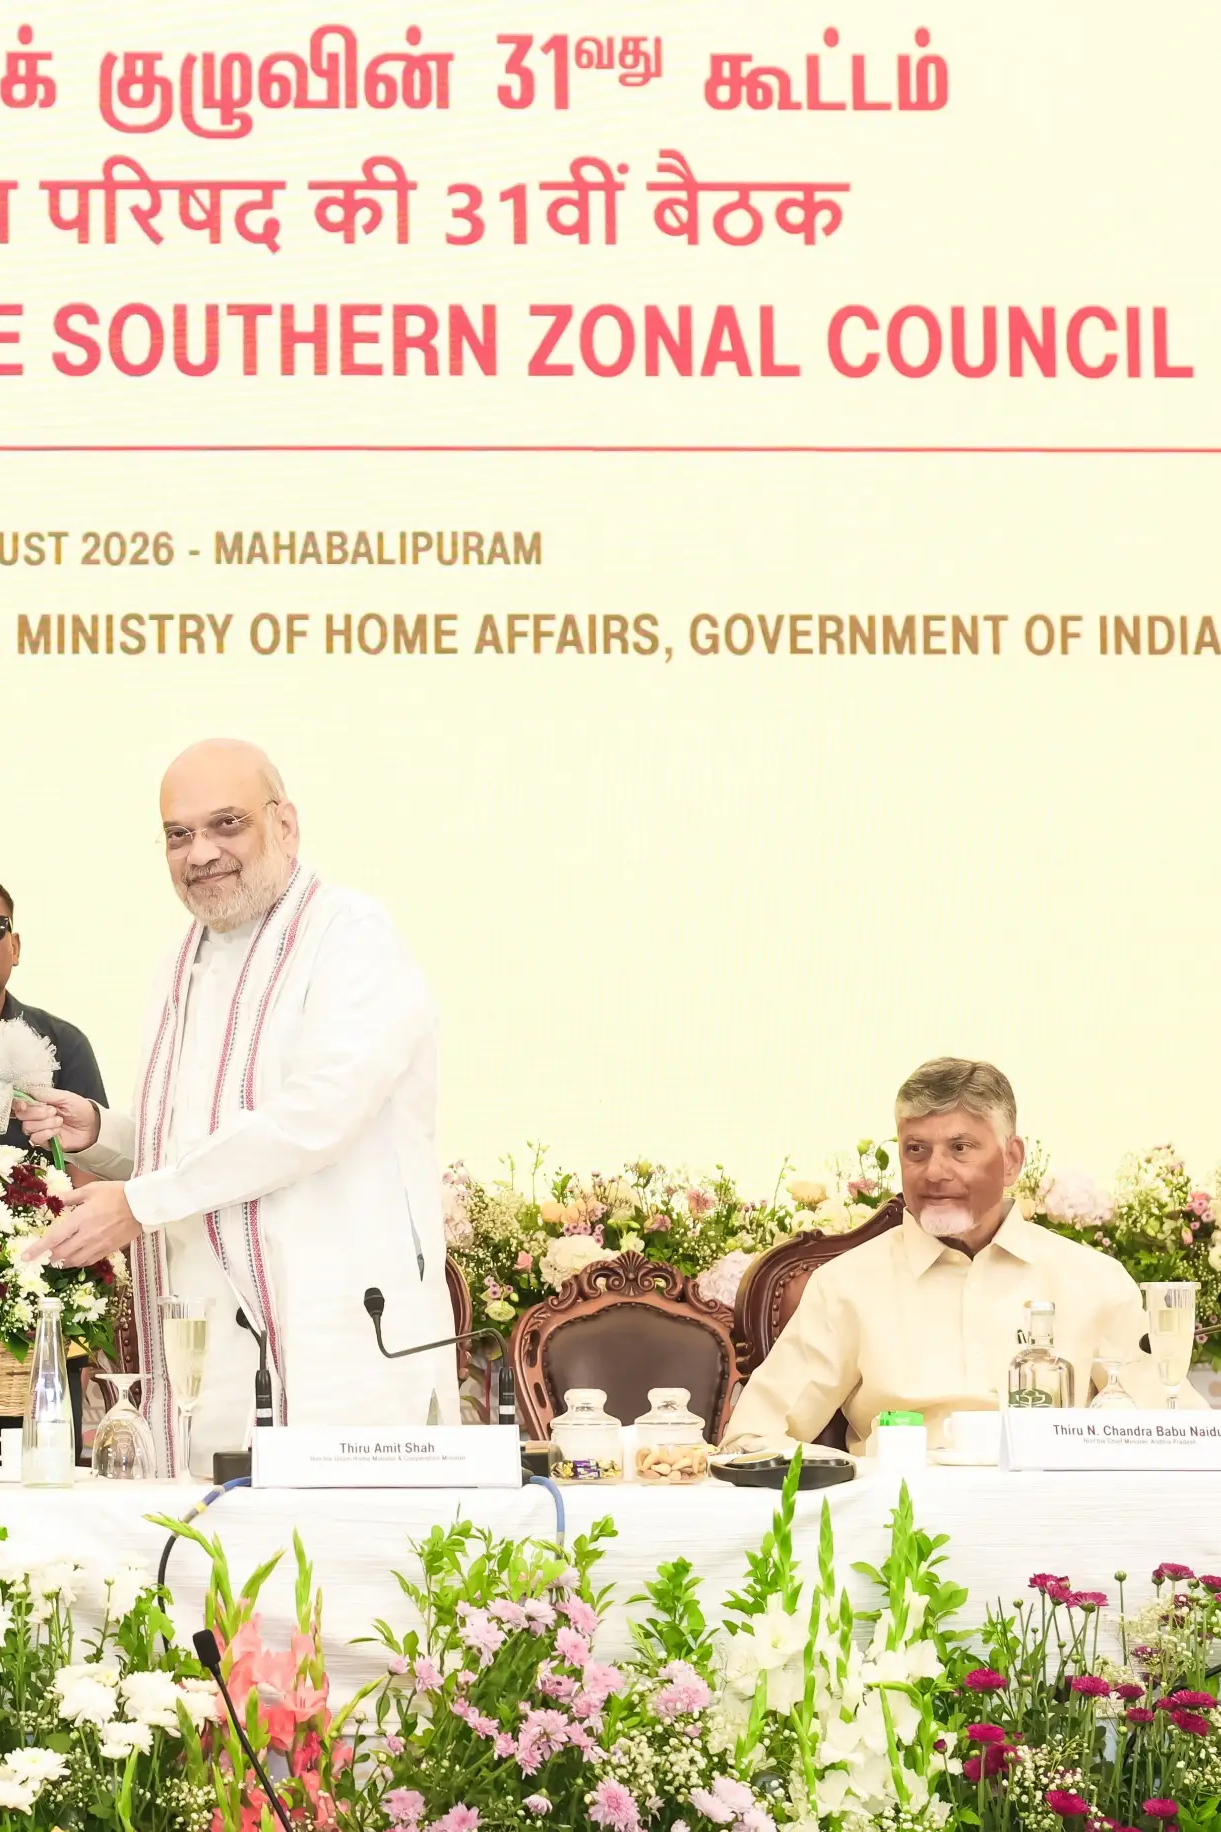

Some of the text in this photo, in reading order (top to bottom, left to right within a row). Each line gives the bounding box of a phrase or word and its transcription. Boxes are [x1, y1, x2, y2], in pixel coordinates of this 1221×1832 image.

[99, 24, 454, 139] குழுவின்
[705, 27, 948, 111] கூட்டம்
[39, 155, 286, 253] परिषद
[308, 156, 417, 244] की
[446, 156, 629, 245] 31वीं
[646, 149, 850, 246] बैठक
[52, 303, 497, 377] SOUTHERN
[528, 304, 800, 377] ZONAL
[828, 305, 1194, 379] COUNCIL
[81, 532, 174, 566] 2026
[216, 532, 542, 566] MAHABALIPURAM
[18, 613, 233, 656] MINISTRY
[250, 613, 309, 656] OF
[326, 613, 457, 656] HOME
[475, 613, 672, 664] AFFAIRS,
[690, 613, 1008, 656] GOVERNMENT
[1025, 613, 1083, 656] OF
[1099, 615, 1221, 656] INDIA
[340, 1442, 435, 1454] Thiru Amit Shah
[1053, 1424, 1083, 1436] Thiru
[1087, 1425, 1100, 1436] N.
[1103, 1425, 1152, 1437] Chandra
[1156, 1425, 1186, 1437] Babu
